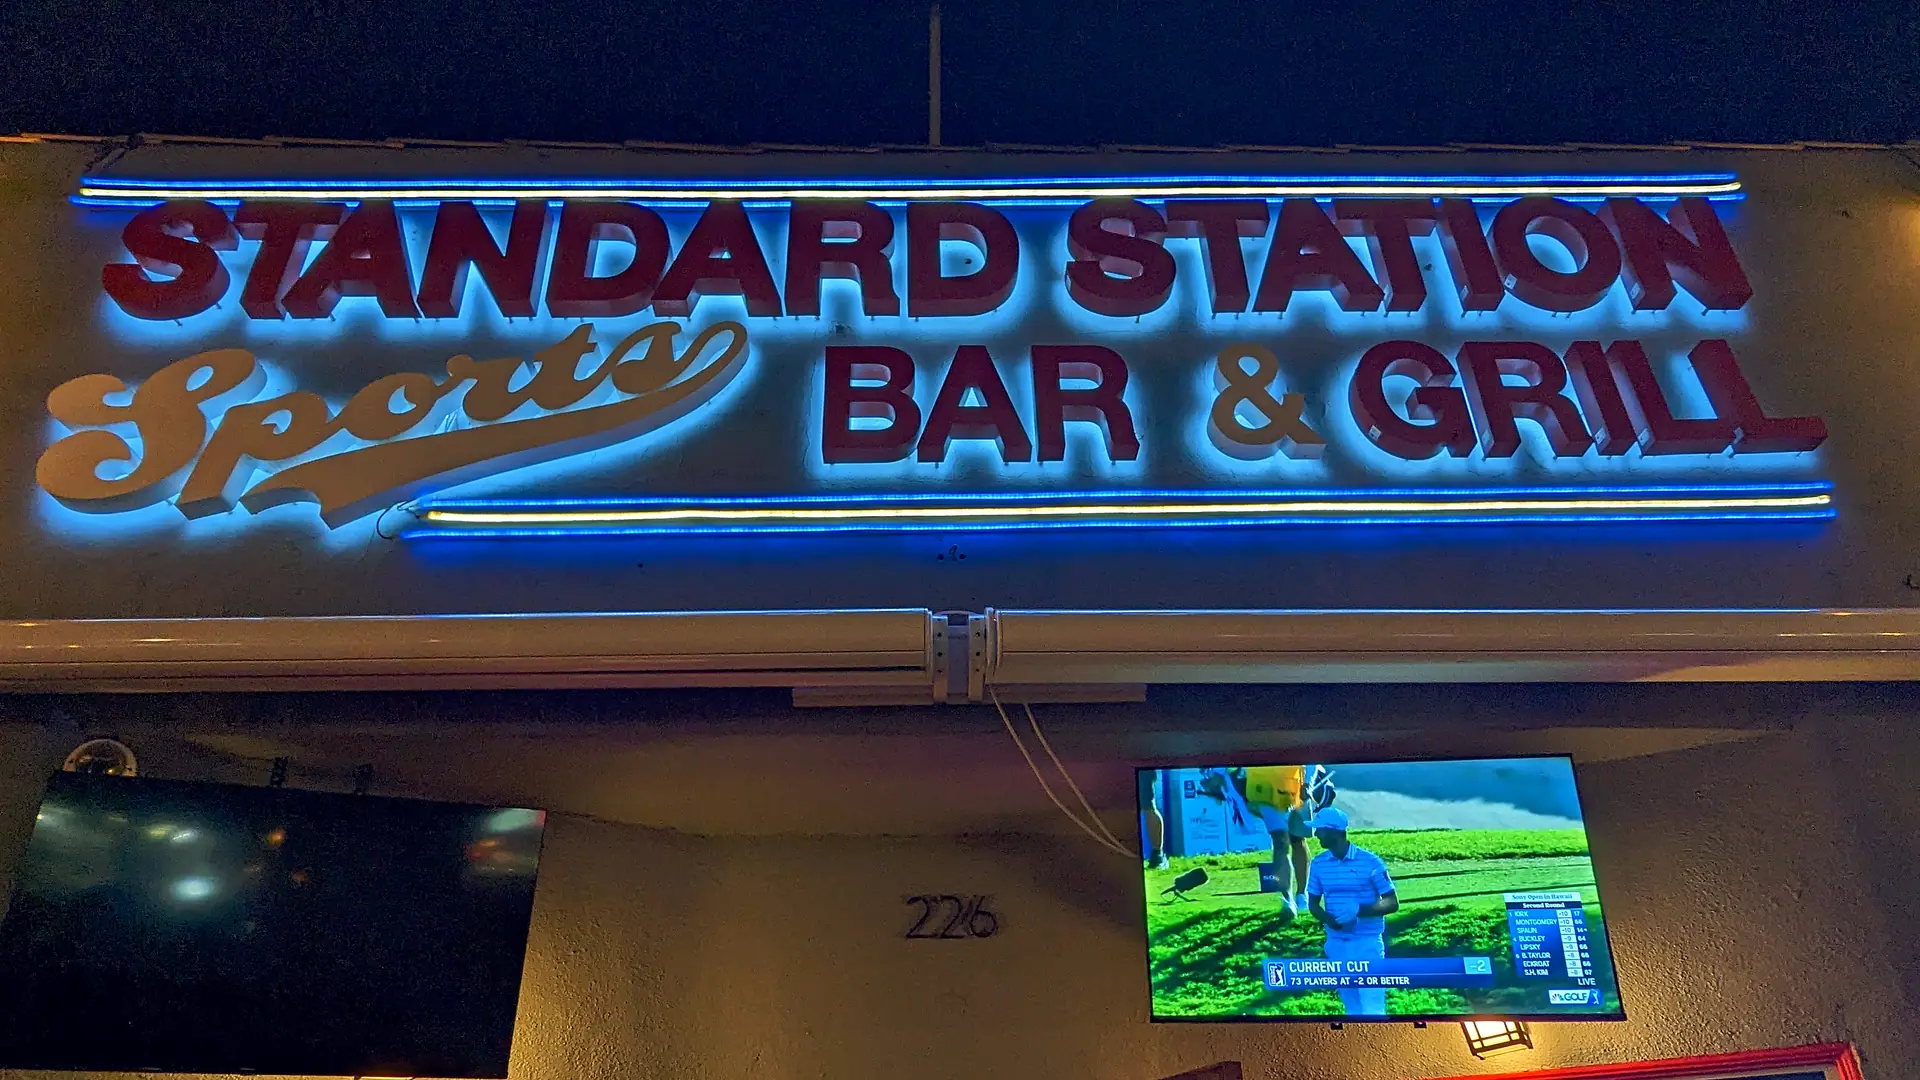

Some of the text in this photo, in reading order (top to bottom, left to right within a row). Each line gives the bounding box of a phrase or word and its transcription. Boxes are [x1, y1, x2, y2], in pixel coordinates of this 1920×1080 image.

[102, 195, 1754, 319] STANDARD STATION
[822, 339, 1828, 464] BAR & GRILL
[36, 321, 748, 525] Sports
[906, 894, 997, 939] 226
[1289, 960, 1486, 972] CURRENT CUT -2
[1304, 977, 1338, 985] PLAYERS
[1340, 977, 1350, 985] AT
[1354, 977, 1364, 985] -2
[1366, 977, 1378, 985] OR
[1380, 977, 1410, 985] BETTER
[1578, 978, 1596, 986] LIVE
[1564, 992, 1588, 1001] GOLF
